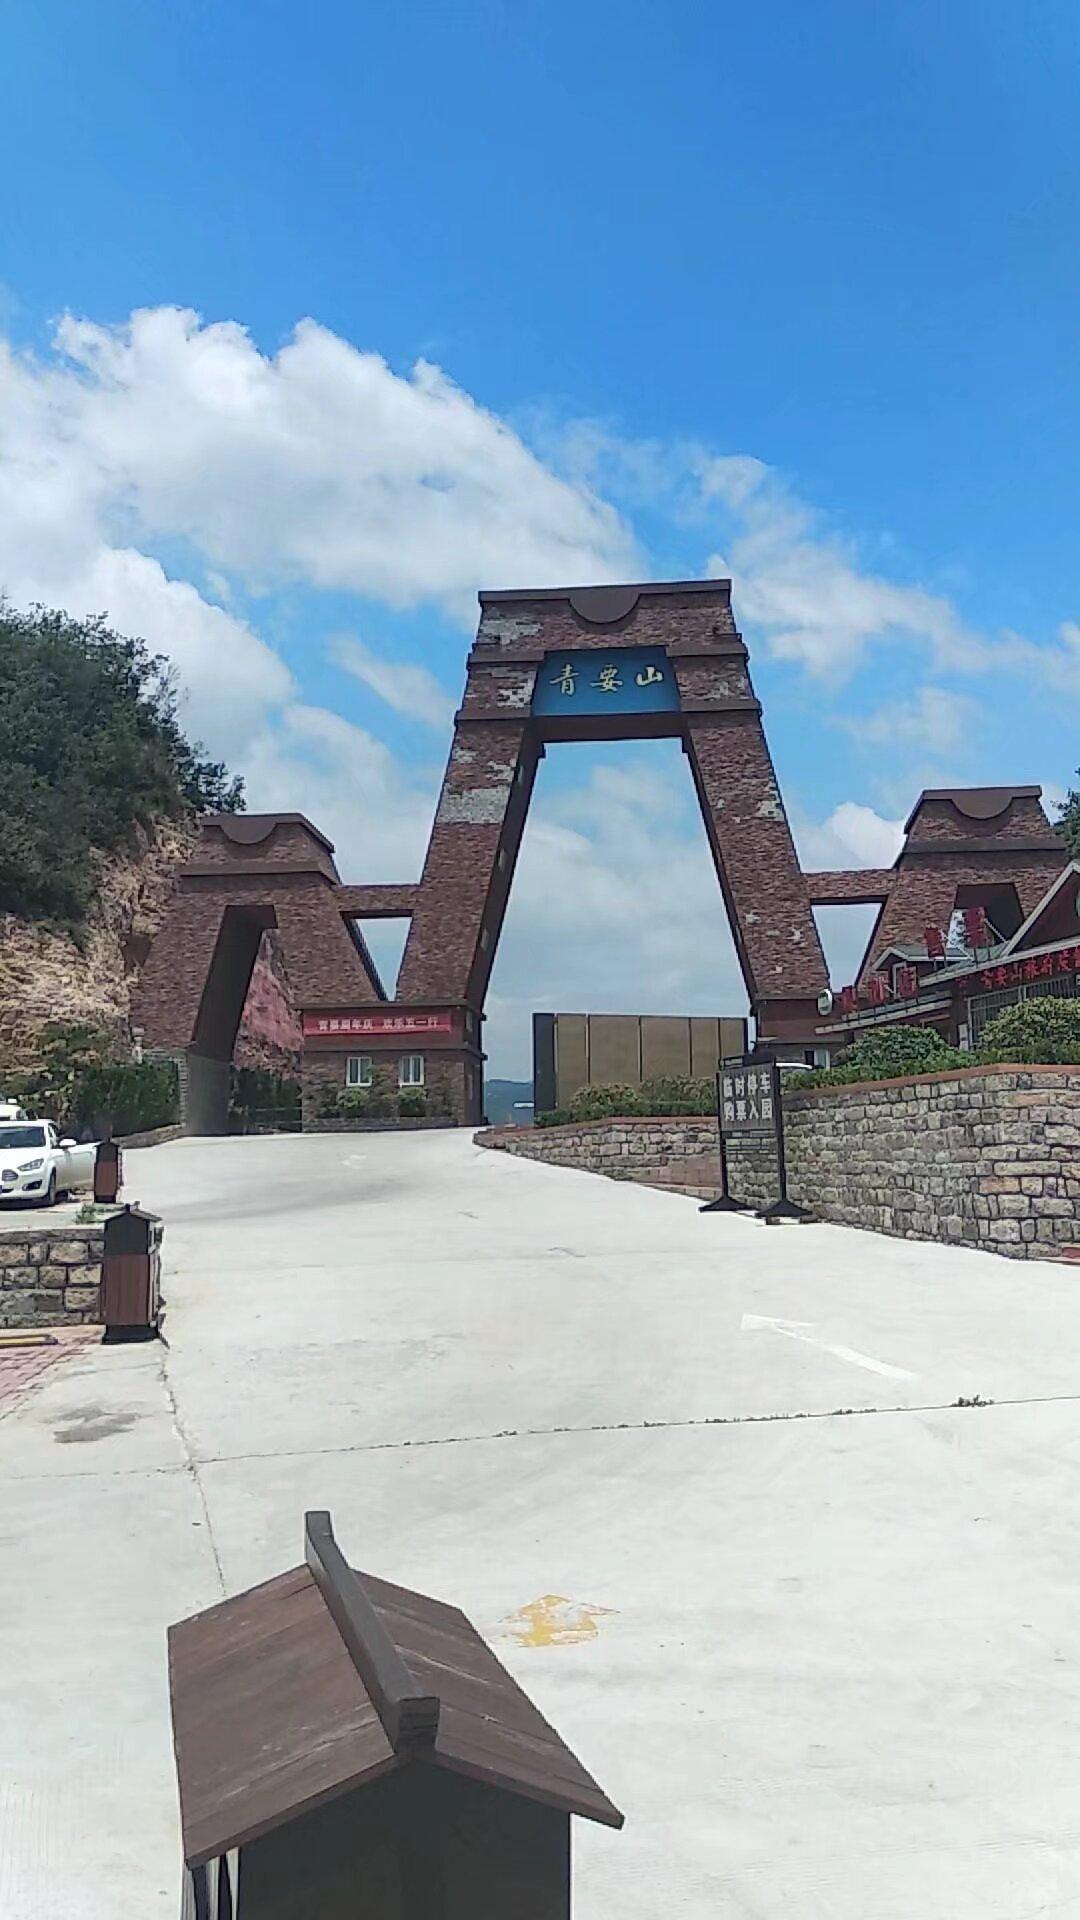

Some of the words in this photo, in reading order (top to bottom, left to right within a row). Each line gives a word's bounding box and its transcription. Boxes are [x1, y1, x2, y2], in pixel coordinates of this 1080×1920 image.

[549, 663, 663, 695] 青安山
[723, 1072, 771, 1098] 临时停车
[723, 1098, 772, 1121] 购票入园
